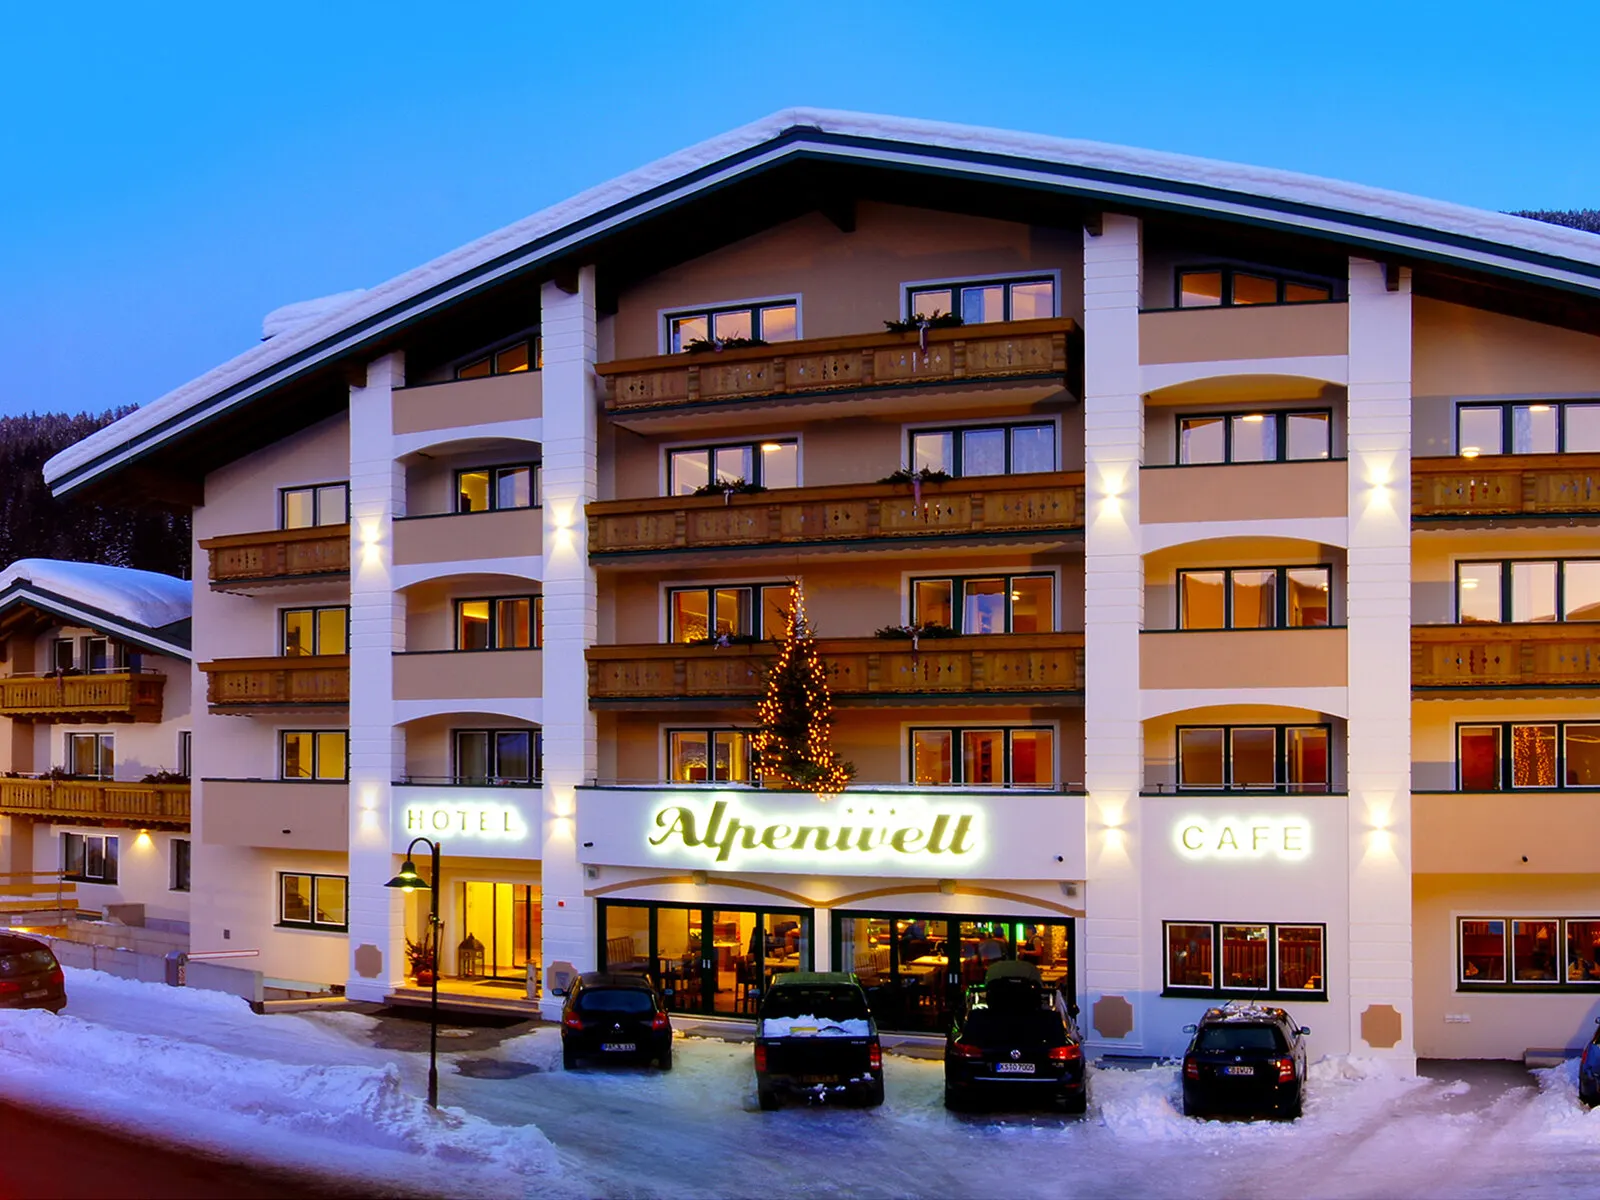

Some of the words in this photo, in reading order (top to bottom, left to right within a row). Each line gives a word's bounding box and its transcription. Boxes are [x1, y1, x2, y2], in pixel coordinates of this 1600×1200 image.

[407, 809, 518, 832] HOTEL
[648, 800, 976, 862] Alpenwelt
[1181, 825, 1303, 851] CAFE
